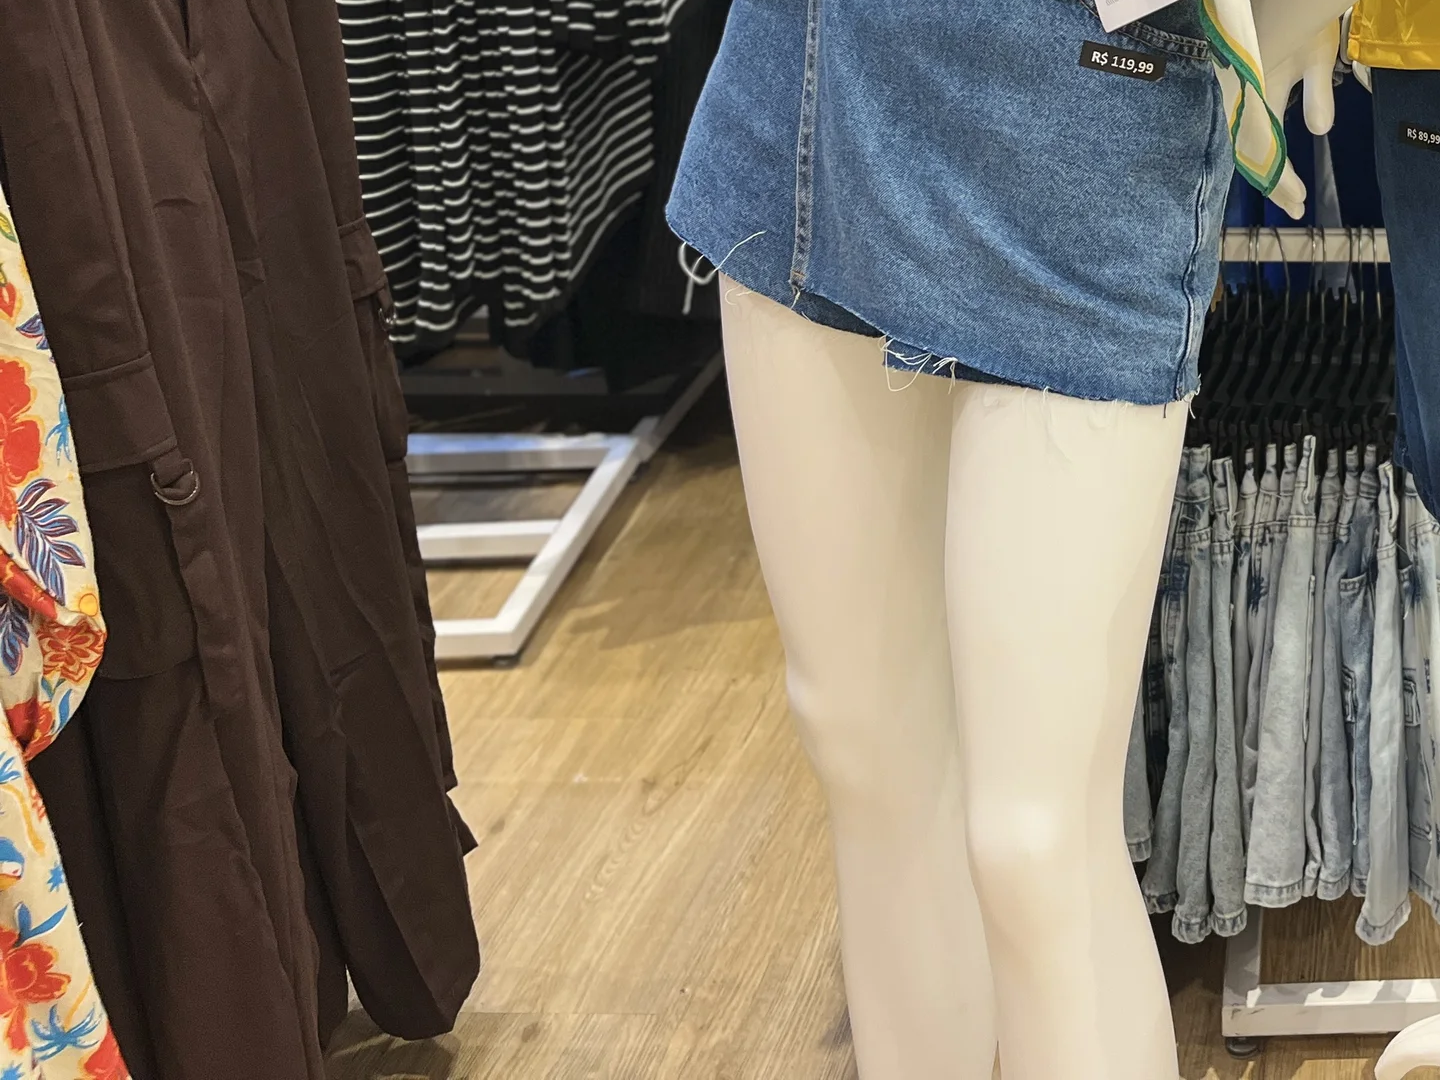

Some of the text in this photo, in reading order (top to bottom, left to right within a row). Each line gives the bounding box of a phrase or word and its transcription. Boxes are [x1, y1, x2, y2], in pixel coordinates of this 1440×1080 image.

[1091, 51, 1154, 74] R$ 119,99
[1407, 128, 1440, 144] R$ 89,99
